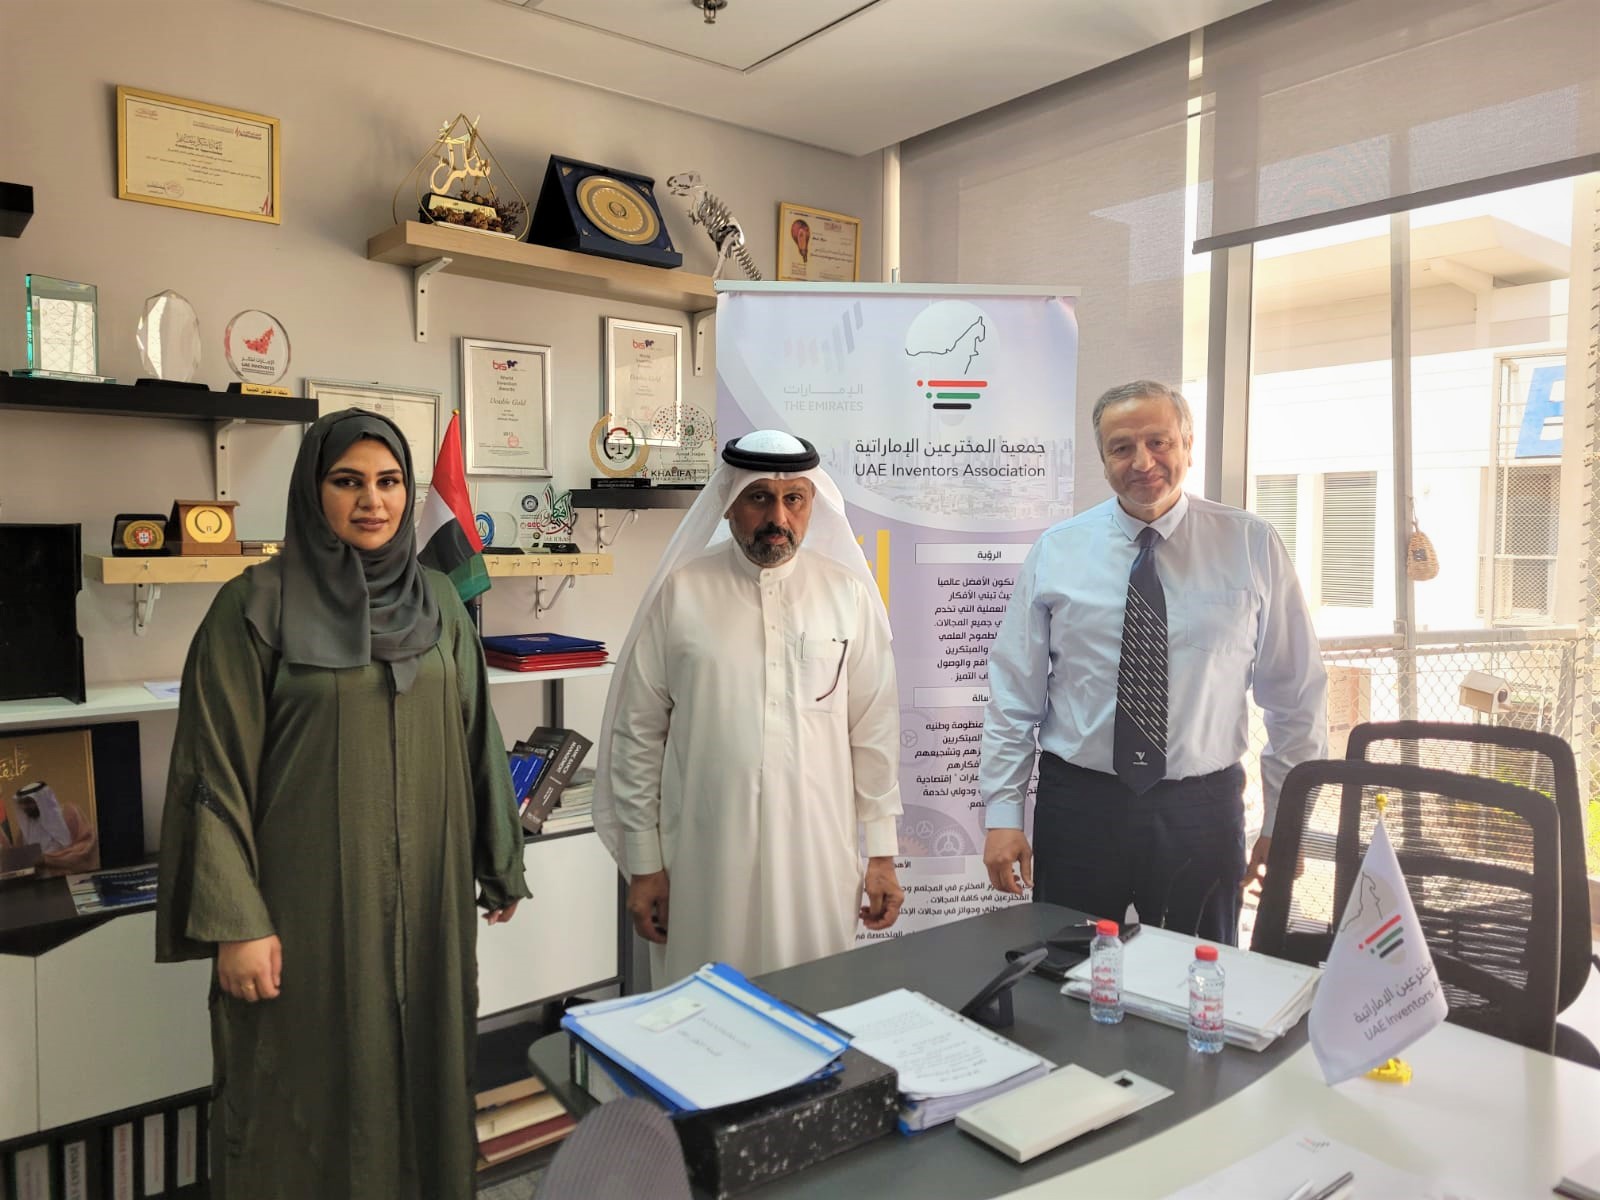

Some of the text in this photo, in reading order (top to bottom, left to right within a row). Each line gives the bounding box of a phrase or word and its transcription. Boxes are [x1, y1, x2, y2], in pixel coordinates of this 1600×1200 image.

[784, 400, 864, 412] THE EMIRATES
[855, 437, 1046, 458] جمعية المخترعين الإماراتية
[855, 464, 1046, 477] UAE Inventors Association
[977, 551, 1002, 561] الرؤية
[962, 576, 990, 587] الأفضل
[948, 589, 976, 602] الأفكار
[934, 605, 956, 616] تخدم
[957, 605, 975, 615] التي
[970, 619, 992, 629] جميع
[938, 631, 966, 641] العلمي
[945, 645, 989, 655] والمبتكرين
[937, 658, 971, 669] والوصول
[972, 693, 990, 702] سالة
[914, 747, 961, 759] وتشجيعهم
[1363, 989, 1435, 1041] UAE Inventors
